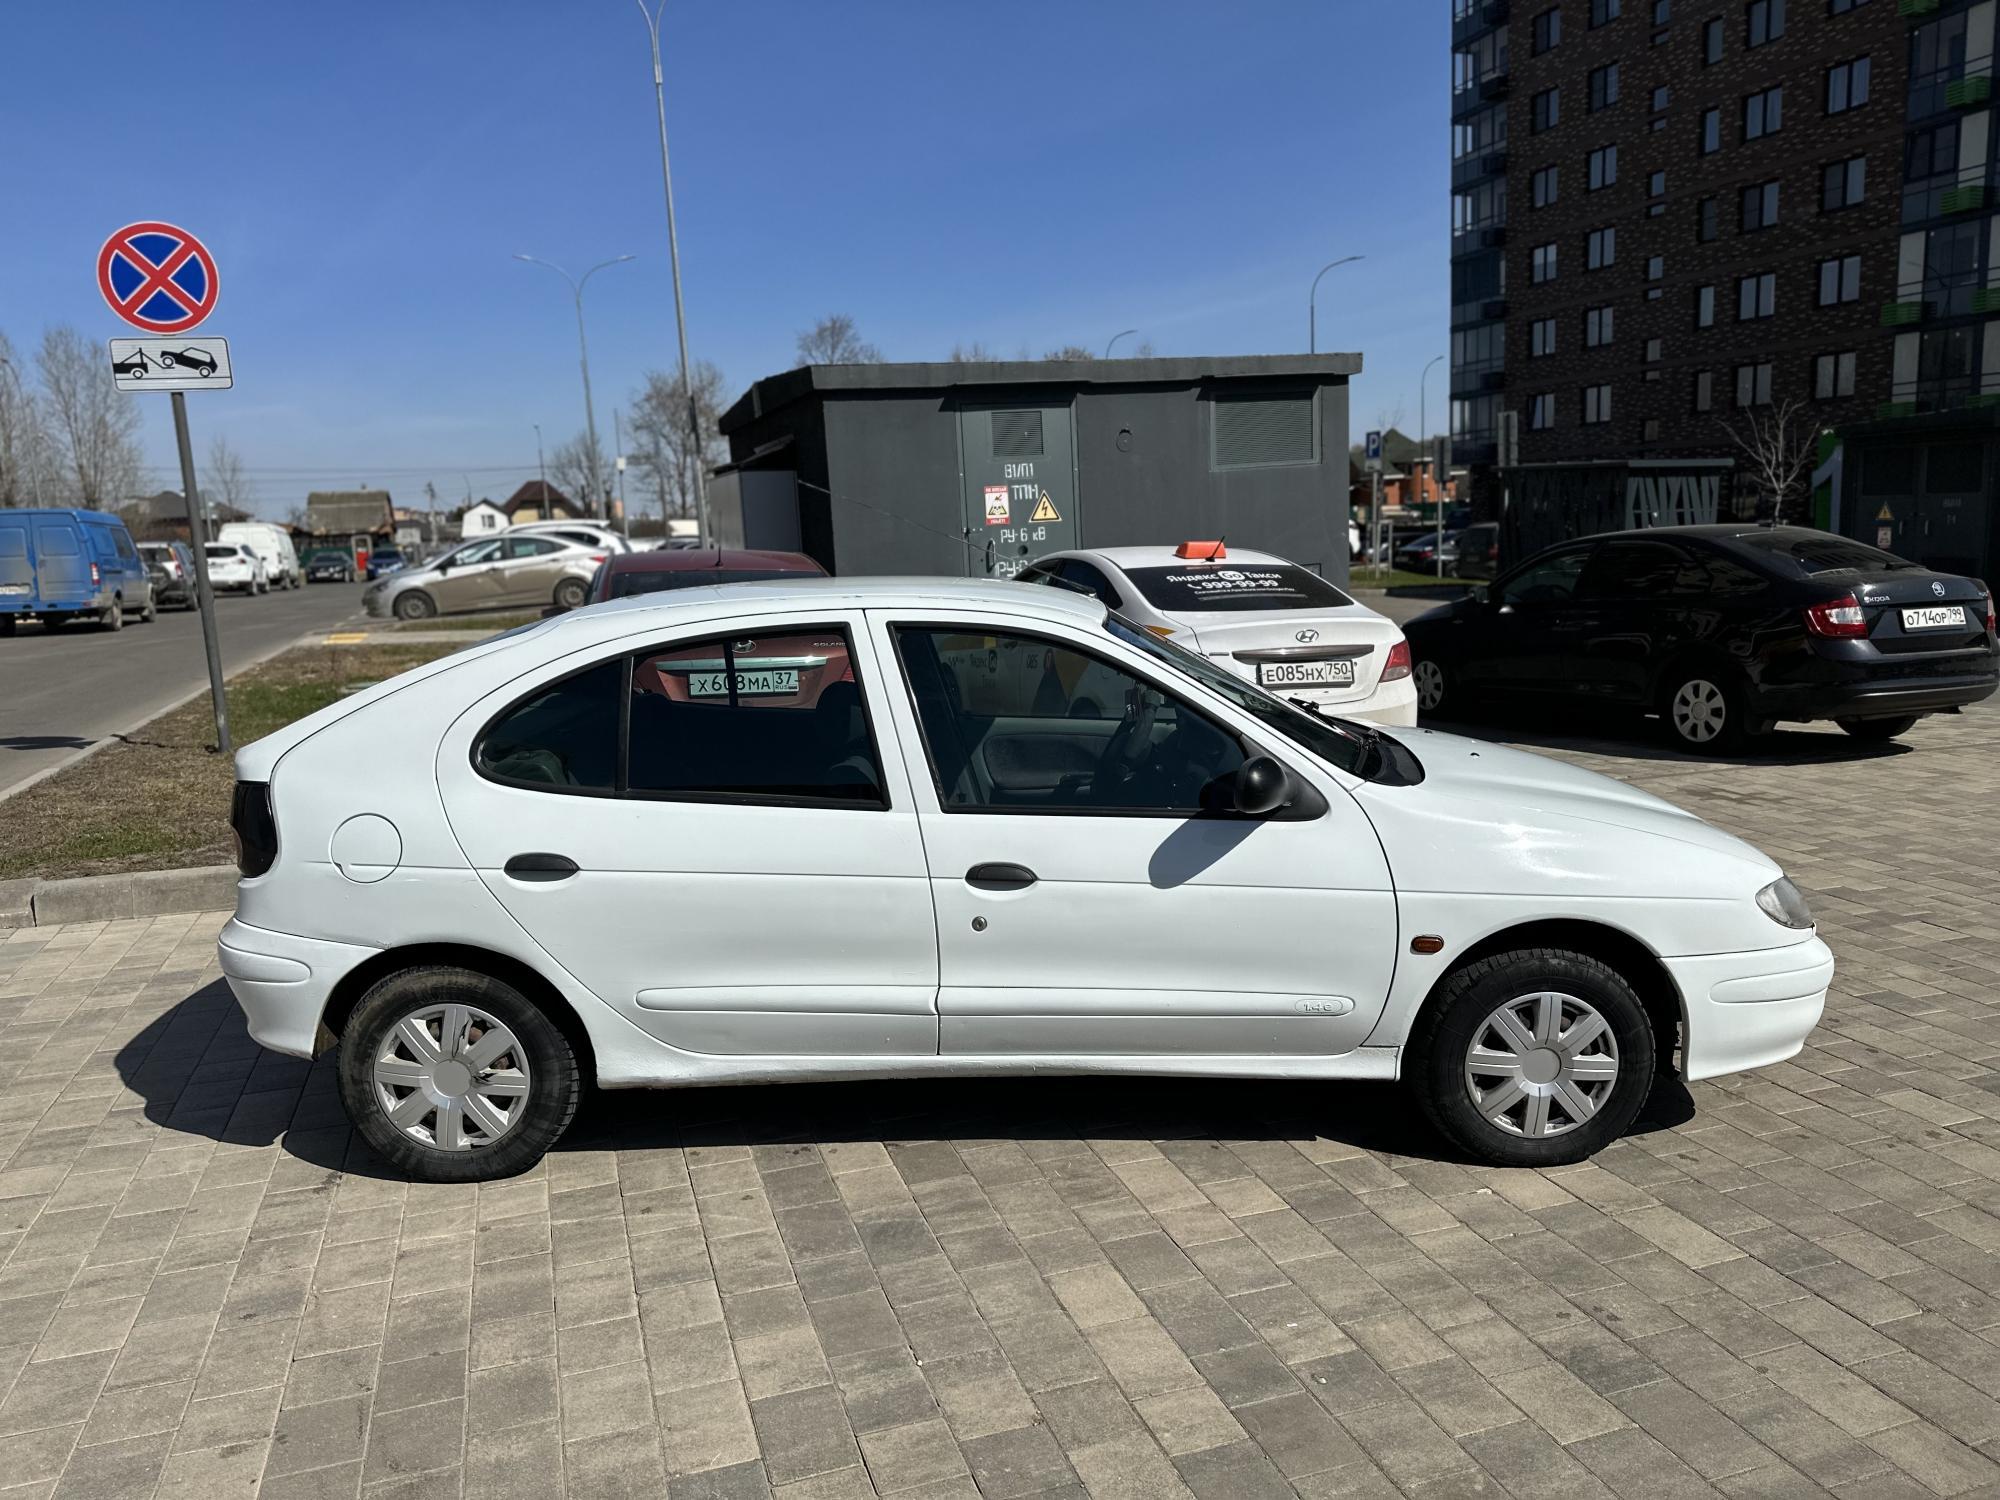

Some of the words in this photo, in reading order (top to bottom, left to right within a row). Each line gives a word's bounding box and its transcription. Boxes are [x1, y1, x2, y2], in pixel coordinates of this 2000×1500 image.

[1369, 434, 1379, 456] P
[1004, 462, 1034, 478] В1/П1
[1011, 483, 1039, 501] ТПН
[1032, 526, 1046, 541] кВ
[1166, 572, 1220, 582] Яндекс
[1243, 571, 1282, 579] Такси
[1201, 579, 1279, 589] 999-99-99
[1947, 608, 1961, 619] 799
[775, 672, 792, 685] 37
[1266, 665, 1325, 682] Е085НХ
[1326, 662, 1348, 676] 750
